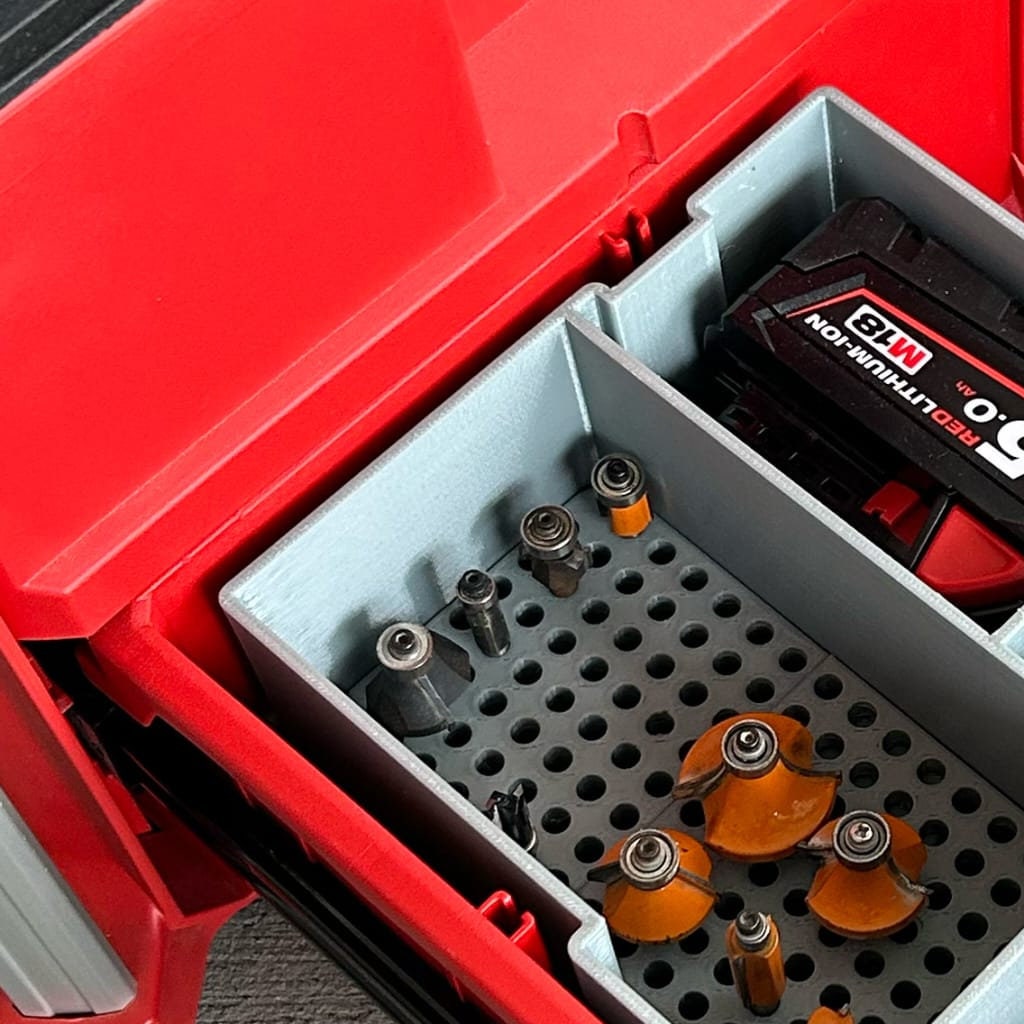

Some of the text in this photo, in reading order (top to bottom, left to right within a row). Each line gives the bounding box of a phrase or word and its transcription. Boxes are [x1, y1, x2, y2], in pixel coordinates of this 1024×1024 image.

[852, 312, 927, 369] M18
[804, 312, 981, 448] REDLITHIUM-ION
[955, 380, 977, 397] Ah
